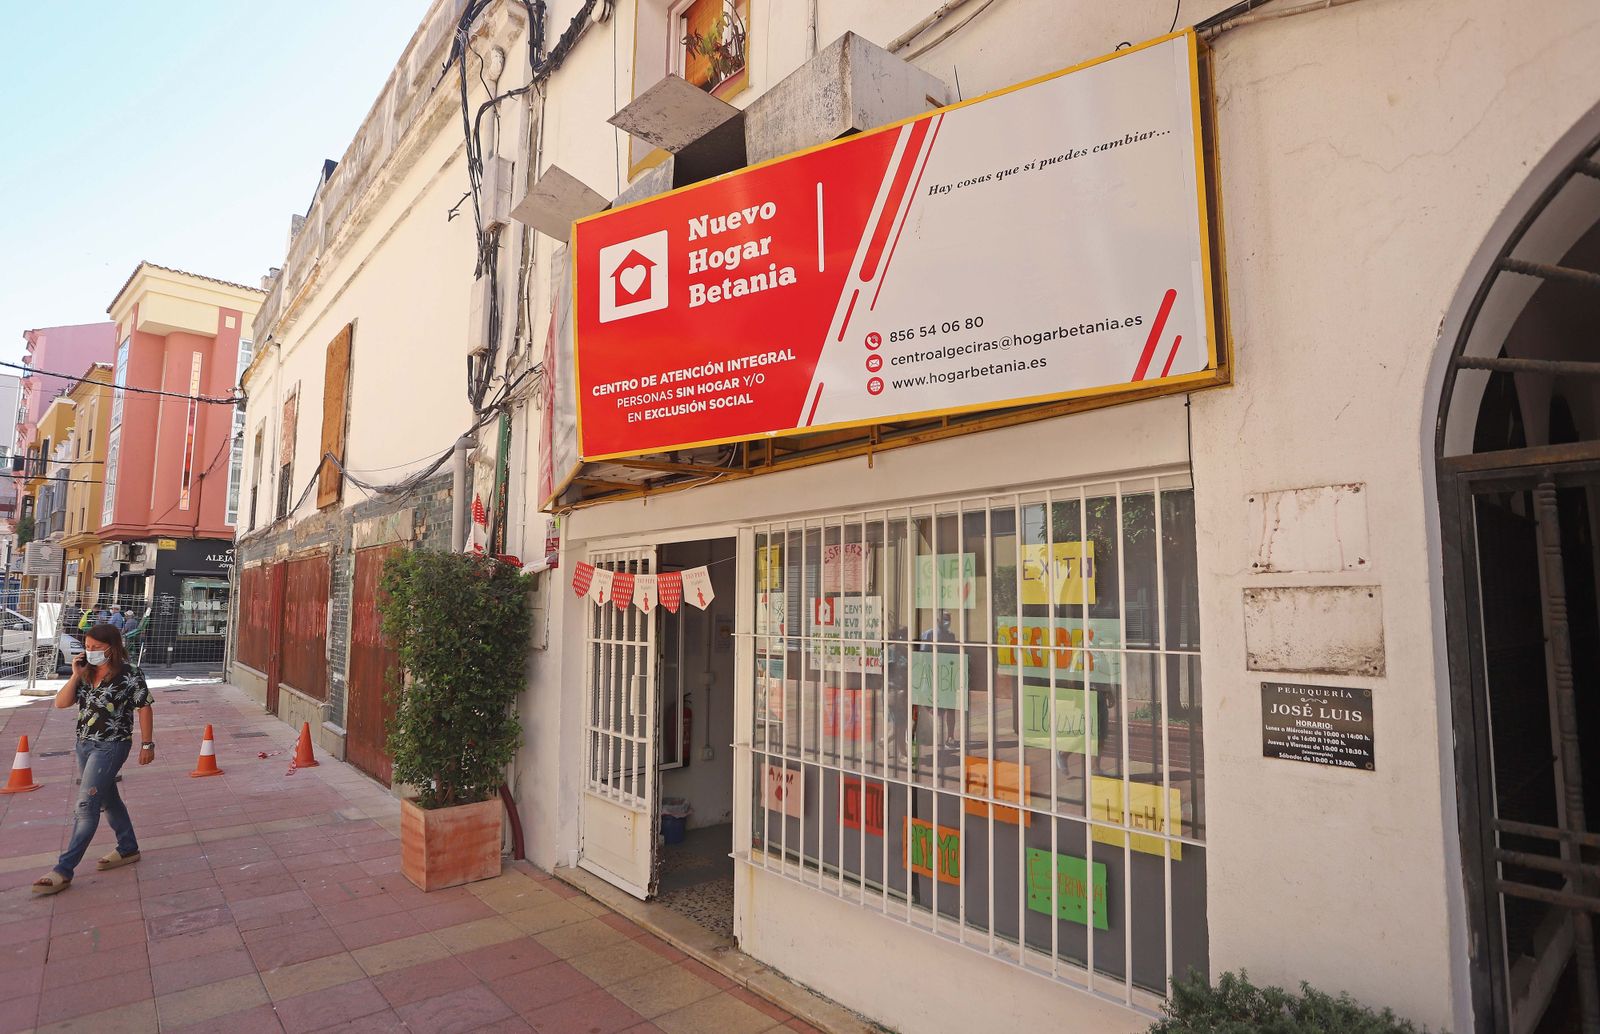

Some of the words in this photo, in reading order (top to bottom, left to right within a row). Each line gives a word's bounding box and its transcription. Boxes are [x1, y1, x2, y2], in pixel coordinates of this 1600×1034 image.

[928, 182, 953, 197] Hay
[957, 173, 992, 189] cosas
[996, 165, 1020, 182] que
[1023, 158, 1036, 172] sí
[1039, 146, 1088, 171] puedes
[1092, 128, 1171, 154] cambiar...
[688, 201, 777, 242] Nuevo
[688, 235, 772, 275] Hogar
[688, 263, 797, 309] Betania
[889, 328, 915, 344] 856
[919, 324, 937, 338] 54
[941, 320, 961, 335] 06
[964, 315, 985, 331] 80
[890, 314, 1143, 368] centroalgeciras@hogarbetania.es
[592, 378, 639, 397] CENTRO
[641, 374, 657, 388] DE
[660, 360, 724, 386] ATENCIÓN
[727, 348, 796, 372] INTEGRAL
[892, 356, 1048, 390] www.hogarbetania.es
[617, 389, 674, 408] PERSONAS
[676, 385, 696, 398] SIN
[697, 378, 740, 394] HOGAR
[743, 372, 765, 388] Y/O
[627, 411, 642, 423] EN
[644, 400, 707, 420] EXCLUSIÓN
[709, 393, 753, 410] SOCIAL
[1277, 686, 1353, 699] PELUQUERÍA
[1270, 703, 1313, 717] JOSÉ
[1320, 707, 1363, 722] LUIS
[1296, 719, 1333, 730] HORARIO:
[1265, 724, 1280, 732] Lunes
[1323, 730, 1339, 738] 10:00
[1346, 732, 1363, 740] 14:00
[1301, 735, 1316, 743] 16:00
[1323, 737, 1339, 745] 19:00
